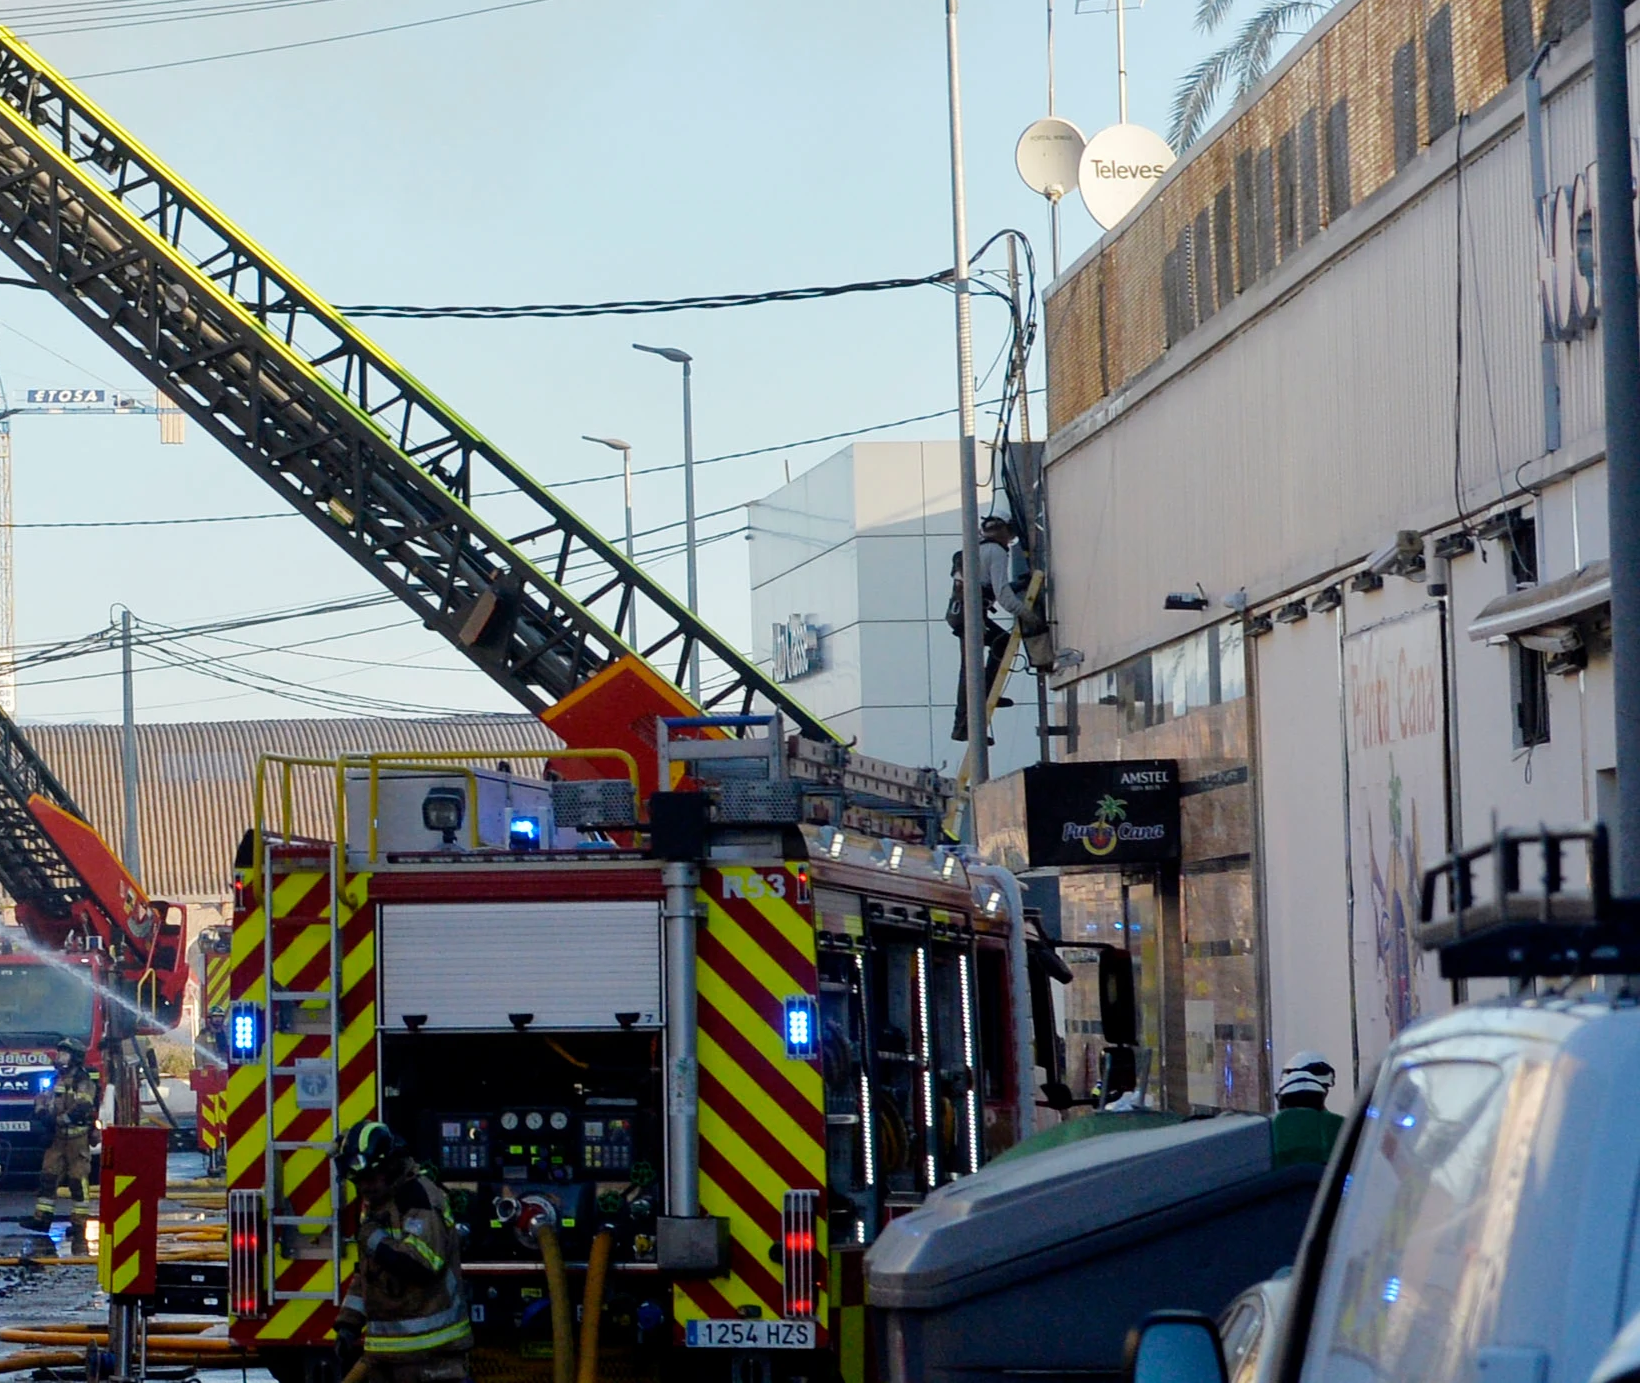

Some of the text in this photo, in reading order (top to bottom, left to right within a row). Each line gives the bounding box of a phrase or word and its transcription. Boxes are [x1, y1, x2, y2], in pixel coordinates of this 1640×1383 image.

[1091, 159, 1165, 179] Televes
[34, 390, 99, 403] ETOSA
[1397, 646, 1436, 740] Cana
[1120, 771, 1170, 784] AMSTEL
[1117, 822, 1166, 841] Cana
[722, 873, 787, 899] R53
[705, 1323, 809, 1345] 1254 HZS
